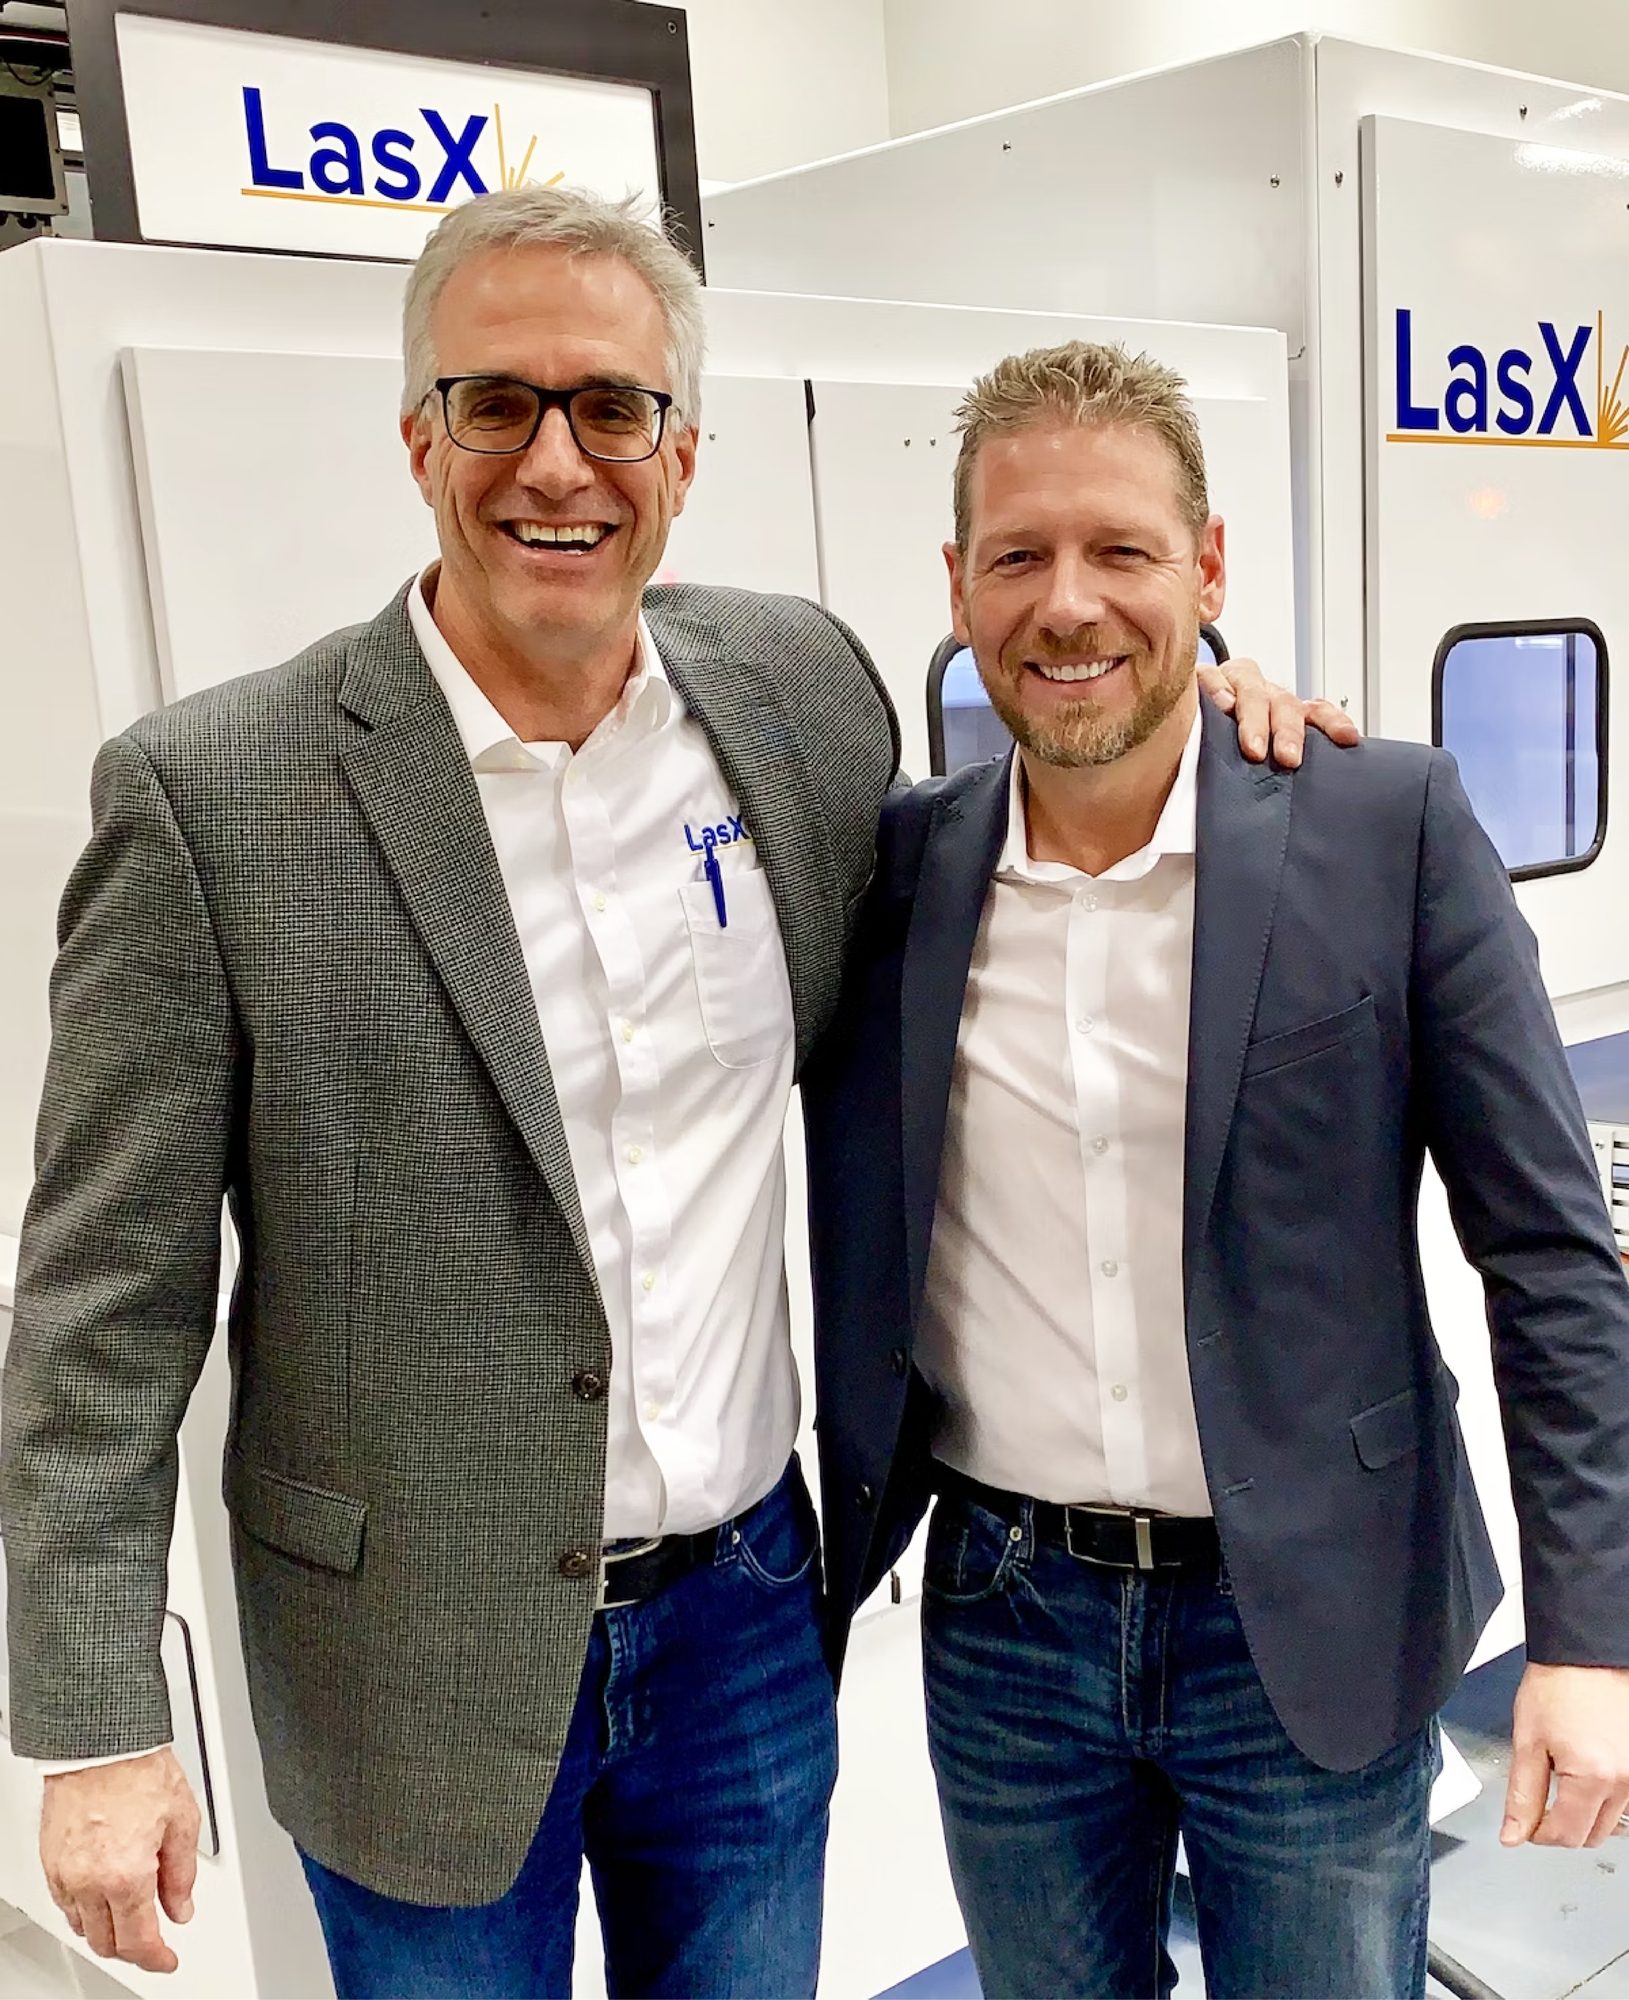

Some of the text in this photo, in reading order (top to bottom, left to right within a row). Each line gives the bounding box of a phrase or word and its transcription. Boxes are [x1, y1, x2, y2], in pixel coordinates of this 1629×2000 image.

[242, 87, 490, 203] LasX
[1396, 308, 1593, 437] LasX
[683, 814, 749, 851] LasX
